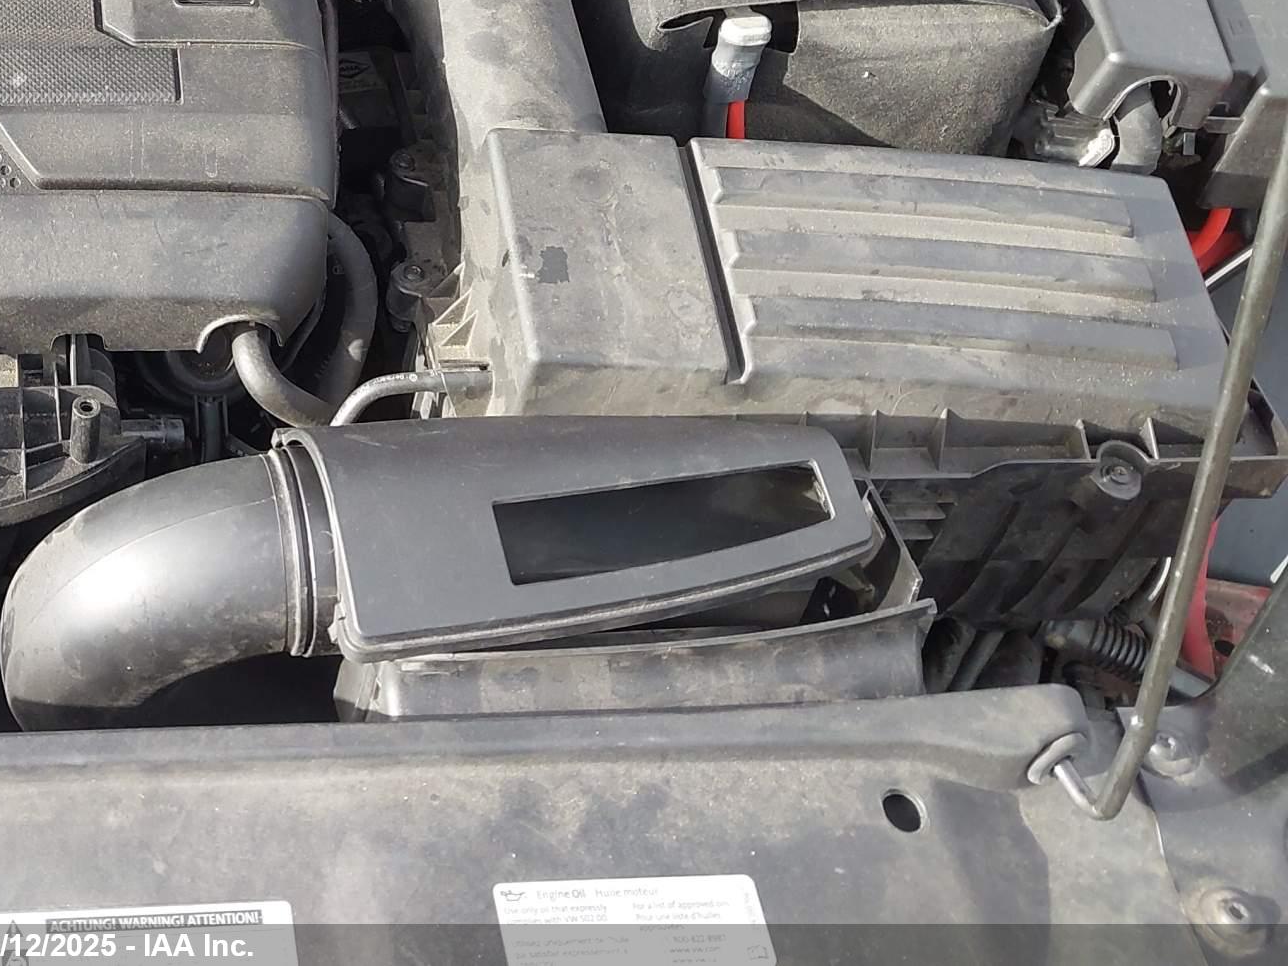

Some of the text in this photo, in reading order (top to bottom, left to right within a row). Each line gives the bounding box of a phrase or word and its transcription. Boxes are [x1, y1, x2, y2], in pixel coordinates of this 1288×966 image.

[50, 911, 260, 933] ACHTUNG! WARNING! ATTENTION!
